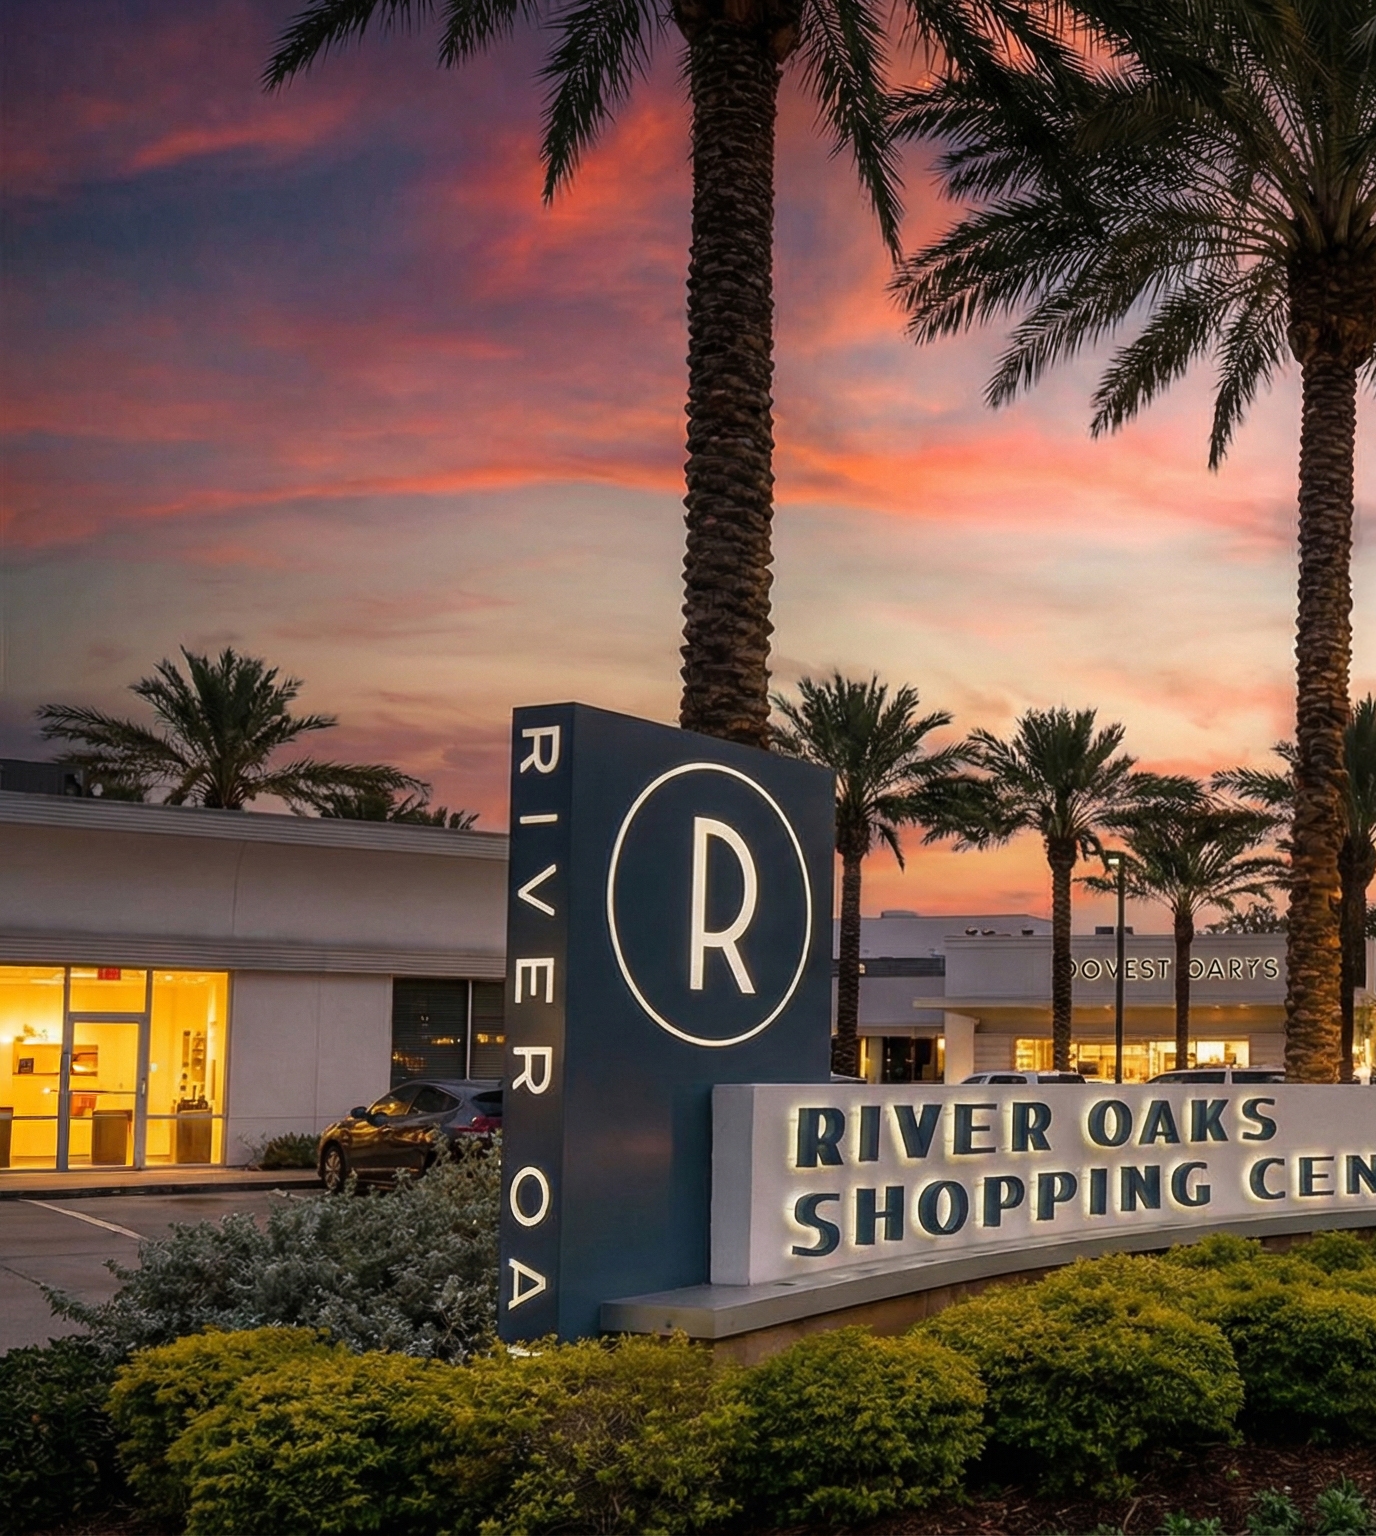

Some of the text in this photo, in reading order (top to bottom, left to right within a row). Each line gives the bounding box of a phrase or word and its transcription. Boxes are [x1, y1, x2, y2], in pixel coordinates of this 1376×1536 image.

[690, 816, 758, 994] R
[506, 725, 560, 1357] RIVER OA
[795, 1098, 1278, 1168] RIVER OAKS
[791, 1161, 1212, 1258] SHOPPING
